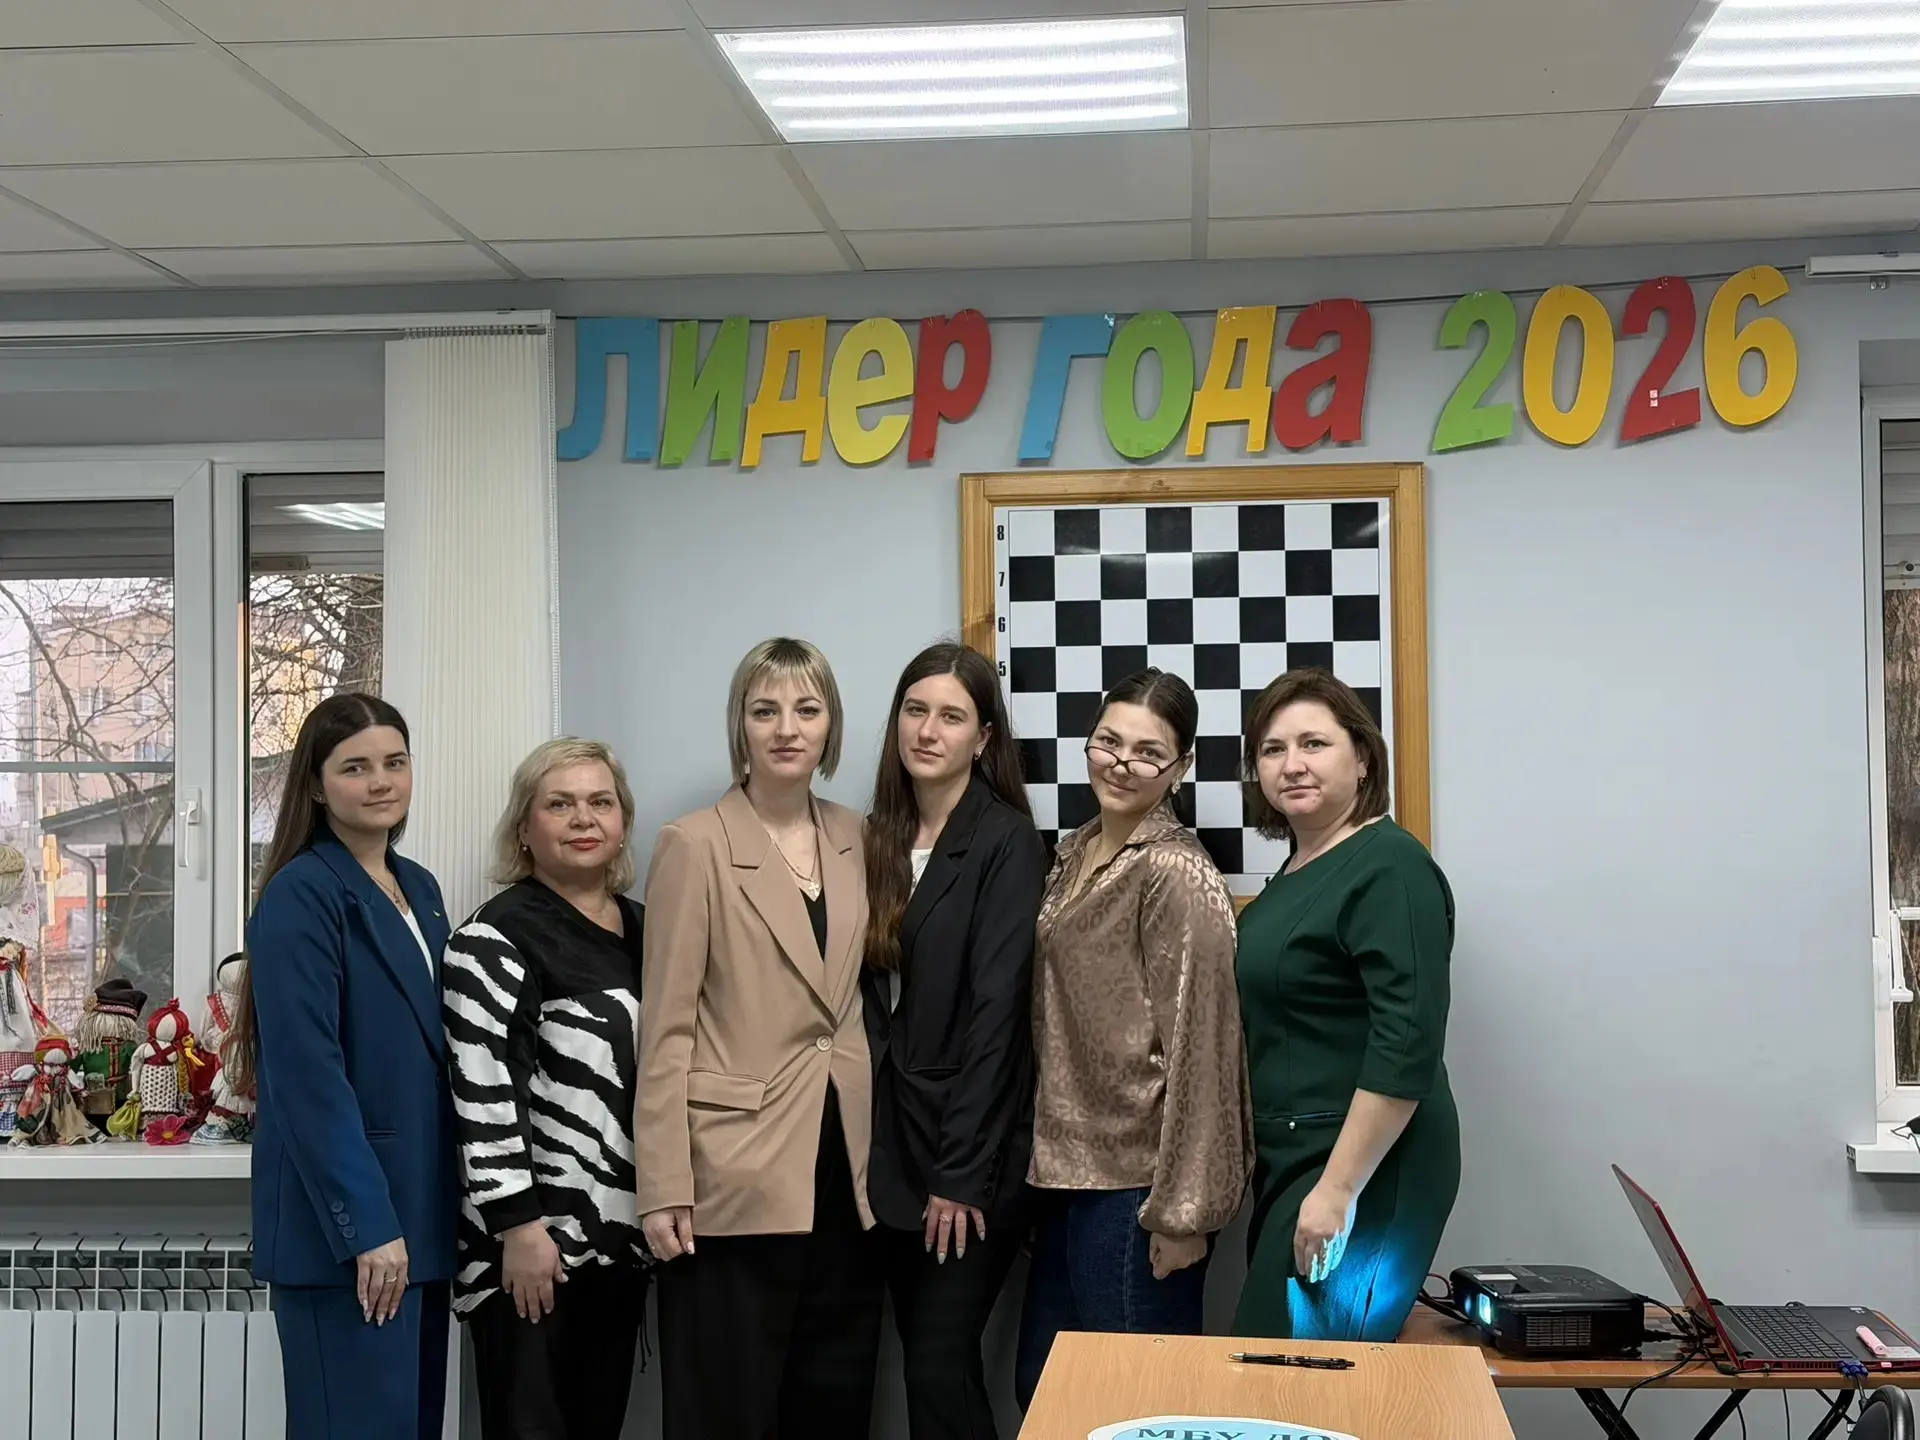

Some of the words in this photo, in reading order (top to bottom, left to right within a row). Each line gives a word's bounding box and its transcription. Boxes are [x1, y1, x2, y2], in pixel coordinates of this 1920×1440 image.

[1431, 265, 1798, 453] 2026
[997, 525, 1005, 541] 8
[998, 571, 1005, 587] 7
[998, 617, 1006, 633] 6
[998, 661, 1006, 677] 5
